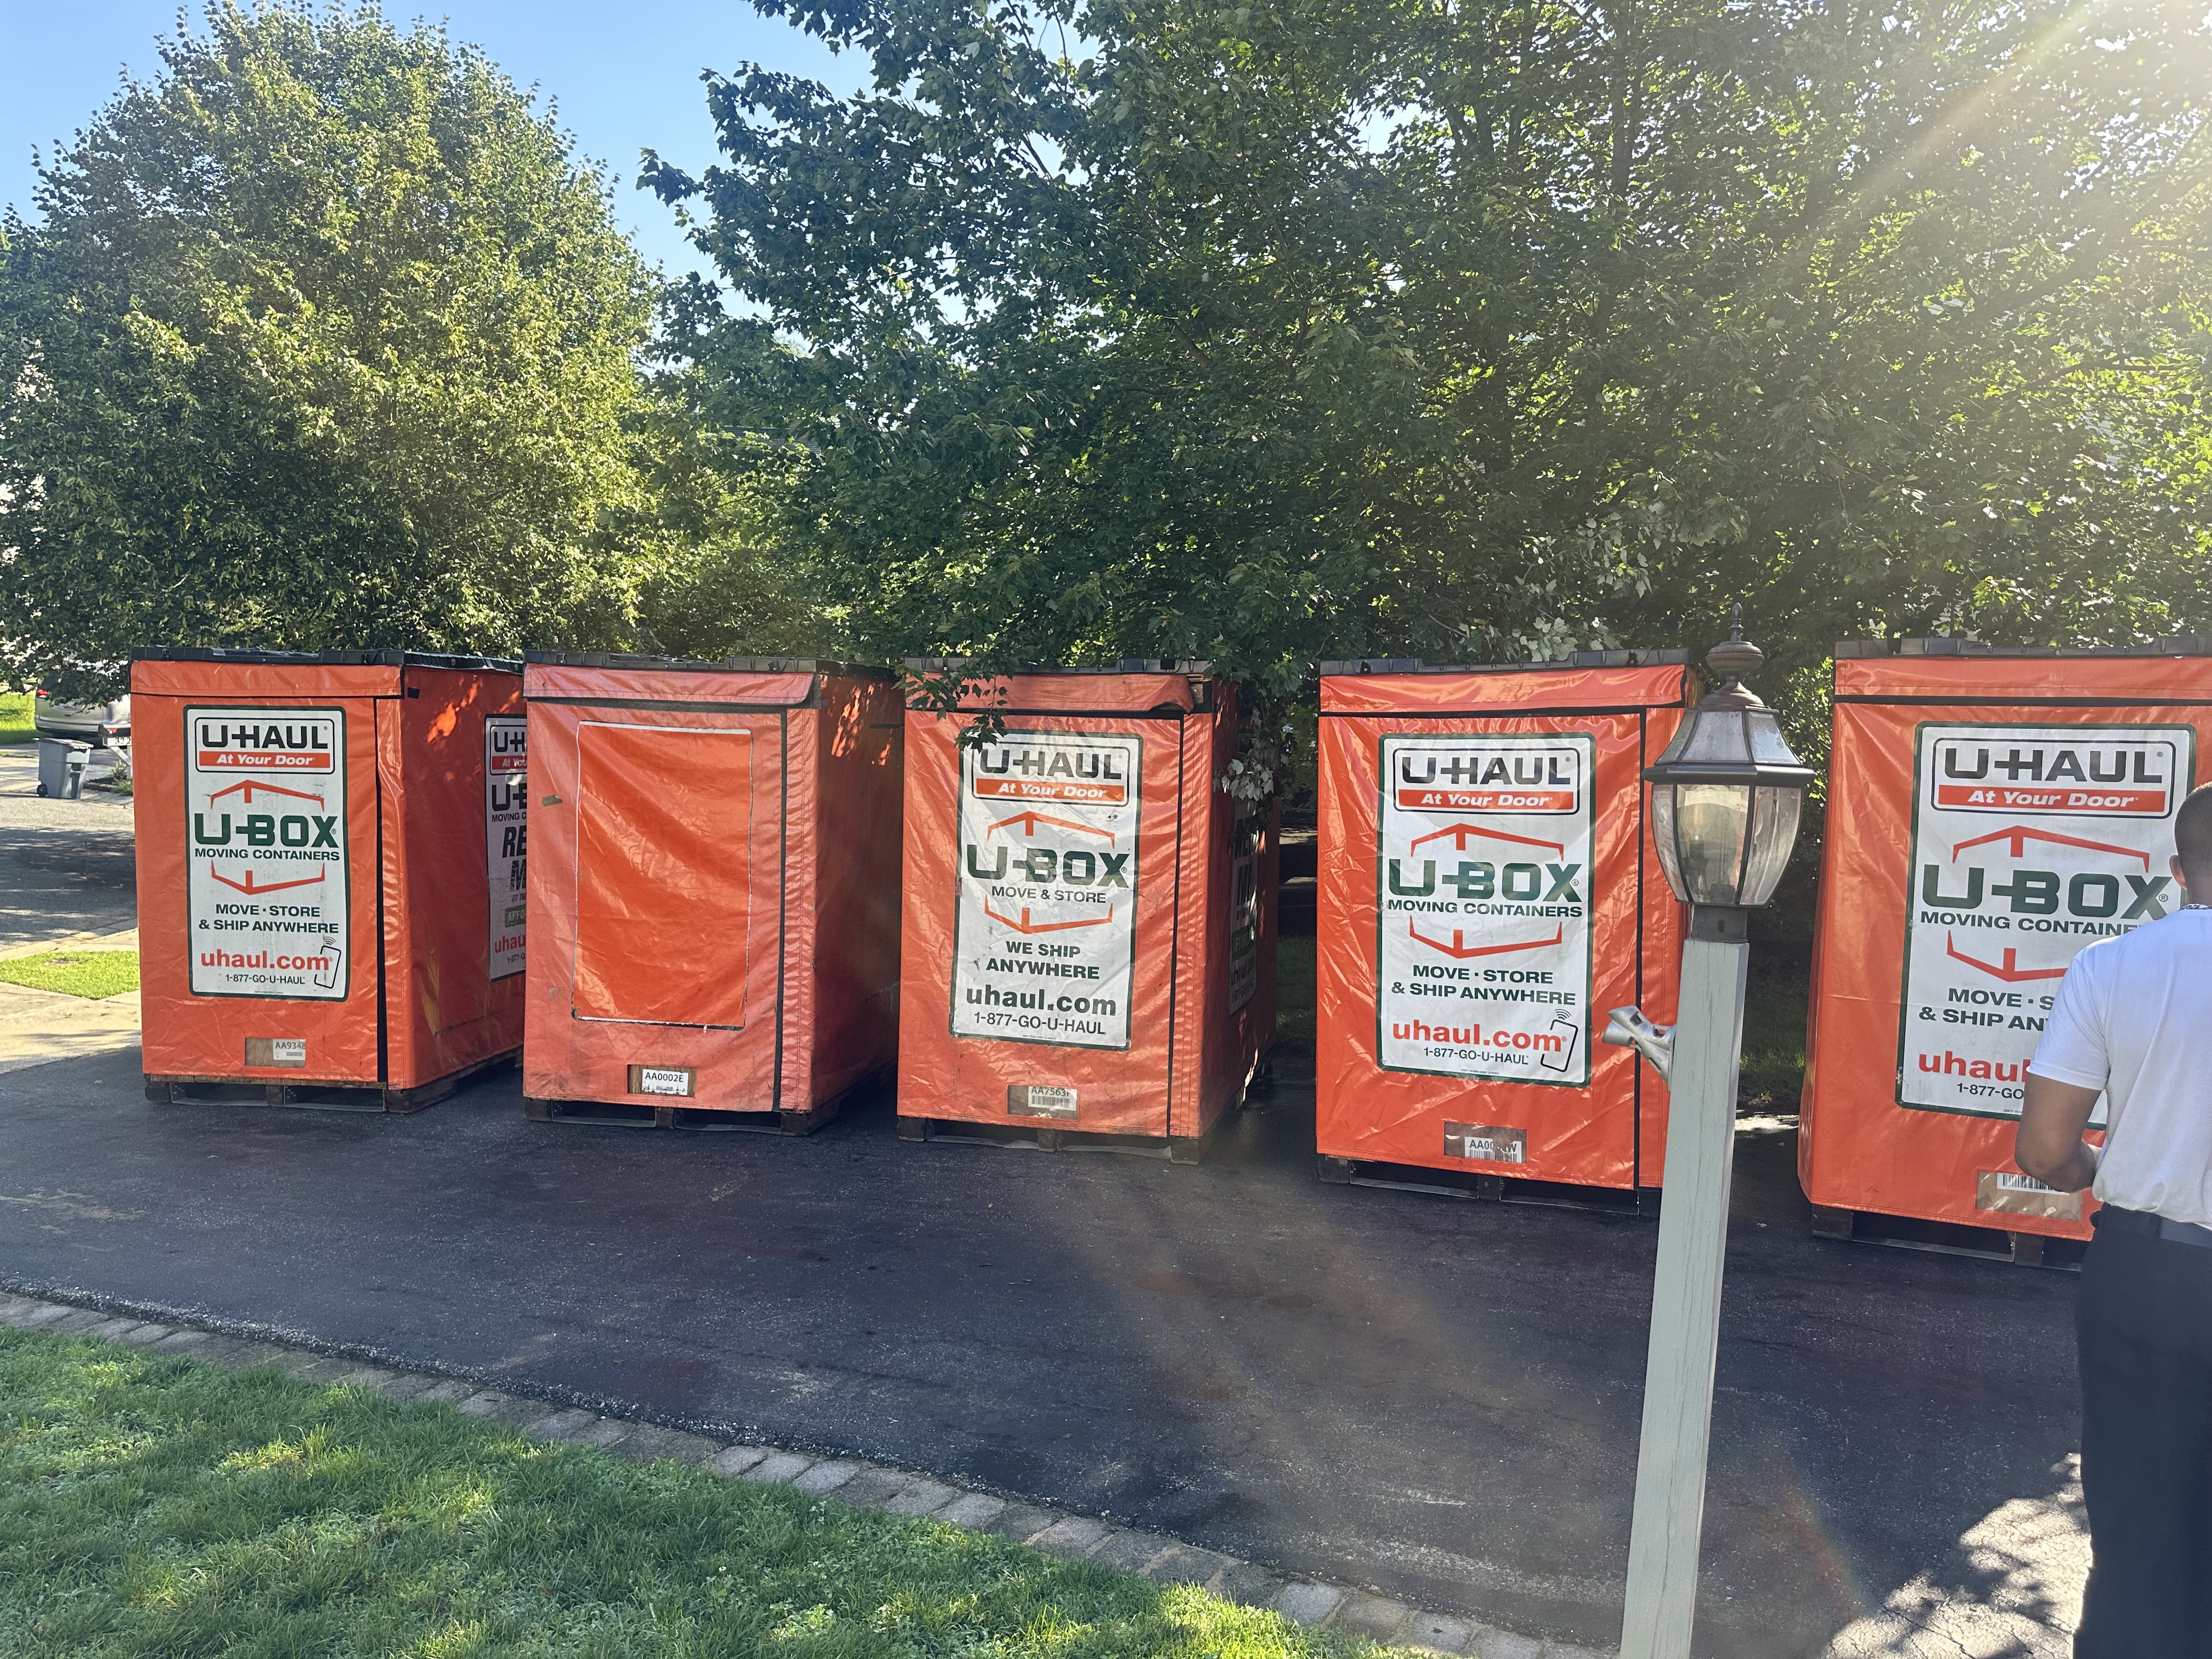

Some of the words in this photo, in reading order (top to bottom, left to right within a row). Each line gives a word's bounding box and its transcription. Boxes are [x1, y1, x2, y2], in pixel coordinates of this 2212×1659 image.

[202, 725, 328, 749] U-HAUL
[494, 731, 527, 752] U-H
[217, 754, 234, 764] At
[238, 754, 272, 765] Your
[275, 755, 313, 765] Door
[503, 758, 511, 767] At
[513, 758, 527, 766] You
[980, 749, 1121, 780] U-HAUL
[998, 783, 1016, 793] At
[1021, 784, 1059, 795] Your
[1063, 786, 1107, 798] Door
[1421, 793, 1442, 804] At
[1448, 794, 1492, 806] Your
[1497, 794, 1549, 806] Door
[1967, 790, 1995, 804] At
[2004, 791, 2061, 806] Your
[2067, 793, 2135, 808] Door
[492, 812, 520, 822] MOVING
[194, 813, 339, 848] U-BOX
[195, 848, 249, 859] MOVING
[252, 850, 340, 861] CONTAINERS
[967, 844, 1130, 888] U-BOX
[1389, 859, 1582, 902] U-BOX
[991, 886, 1036, 898] MOVE
[1041, 890, 1051, 900] &
[1054, 890, 1106, 904] STORE
[1922, 864, 2172, 921] U-BOX
[216, 904, 259, 915] MOVE
[269, 906, 320, 917] STORE
[1388, 900, 1458, 913] MOVING
[1464, 902, 1582, 917] CONTAINERS
[199, 919, 210, 929] &
[214, 920, 249, 930] SHIP
[252, 921, 339, 933] ANYWHERE
[1920, 911, 2010, 929] MOVING
[2018, 918, 2144, 936] CONTAINE
[1006, 941, 1032, 954] WE
[1038, 944, 1080, 957] SHIP
[201, 949, 329, 970] uhaul.com
[986, 958, 1099, 979] ANYWHERE
[225, 974, 305, 984] 1-877-GO-U-HAUL
[1413, 965, 1470, 980] MOVE
[1483, 969, 1553, 984] STORE
[966, 984, 1116, 1016] uhaul.com
[1391, 981, 1405, 994] &
[1409, 983, 1457, 997] SHIP
[1460, 987, 1576, 1006] ANYWHERE
[1948, 988, 2022, 1007] MOVE
[974, 1012, 1106, 1035] 1-877-GO-U-HAUL
[1918, 1007, 1937, 1021] &
[1943, 1009, 2004, 1026] SHIP
[2007, 1015, 2047, 1031] AN
[1393, 1019, 1561, 1052] uhaul.com
[1424, 1047, 1528, 1064] 1-877-GO-U-HAUL
[645, 1072, 684, 1082] AA0002E
